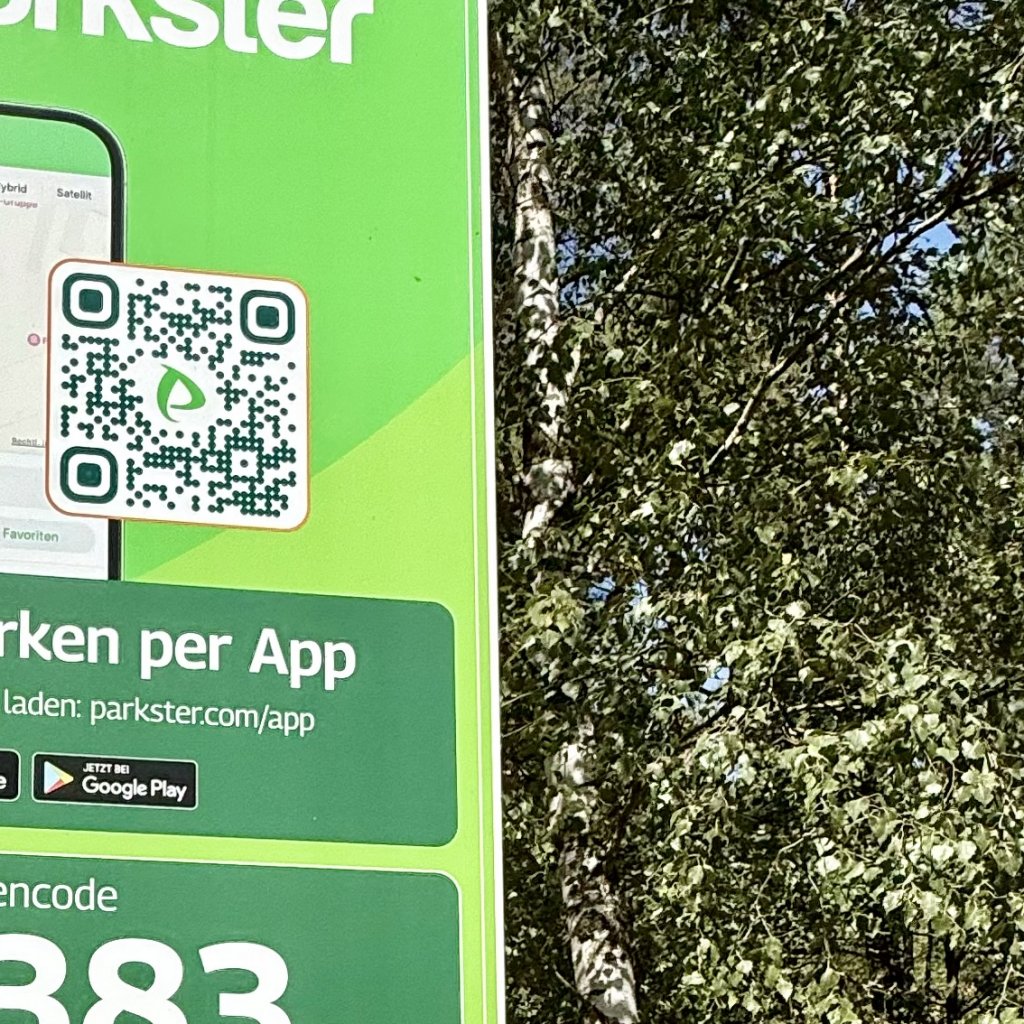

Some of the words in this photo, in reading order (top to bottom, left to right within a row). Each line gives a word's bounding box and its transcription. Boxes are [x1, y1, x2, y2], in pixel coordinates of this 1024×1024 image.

[56, 188, 92, 200] Satellit
[2, 527, 59, 542] Favoriten
[140, 628, 233, 680] per
[248, 627, 357, 690] App
[4, 689, 81, 718] laden:
[90, 697, 315, 738] parkster.com/app
[82, 762, 112, 774] JETZT
[113, 763, 130, 775] BEI
[82, 775, 147, 801] Google
[150, 780, 187, 803] Play
